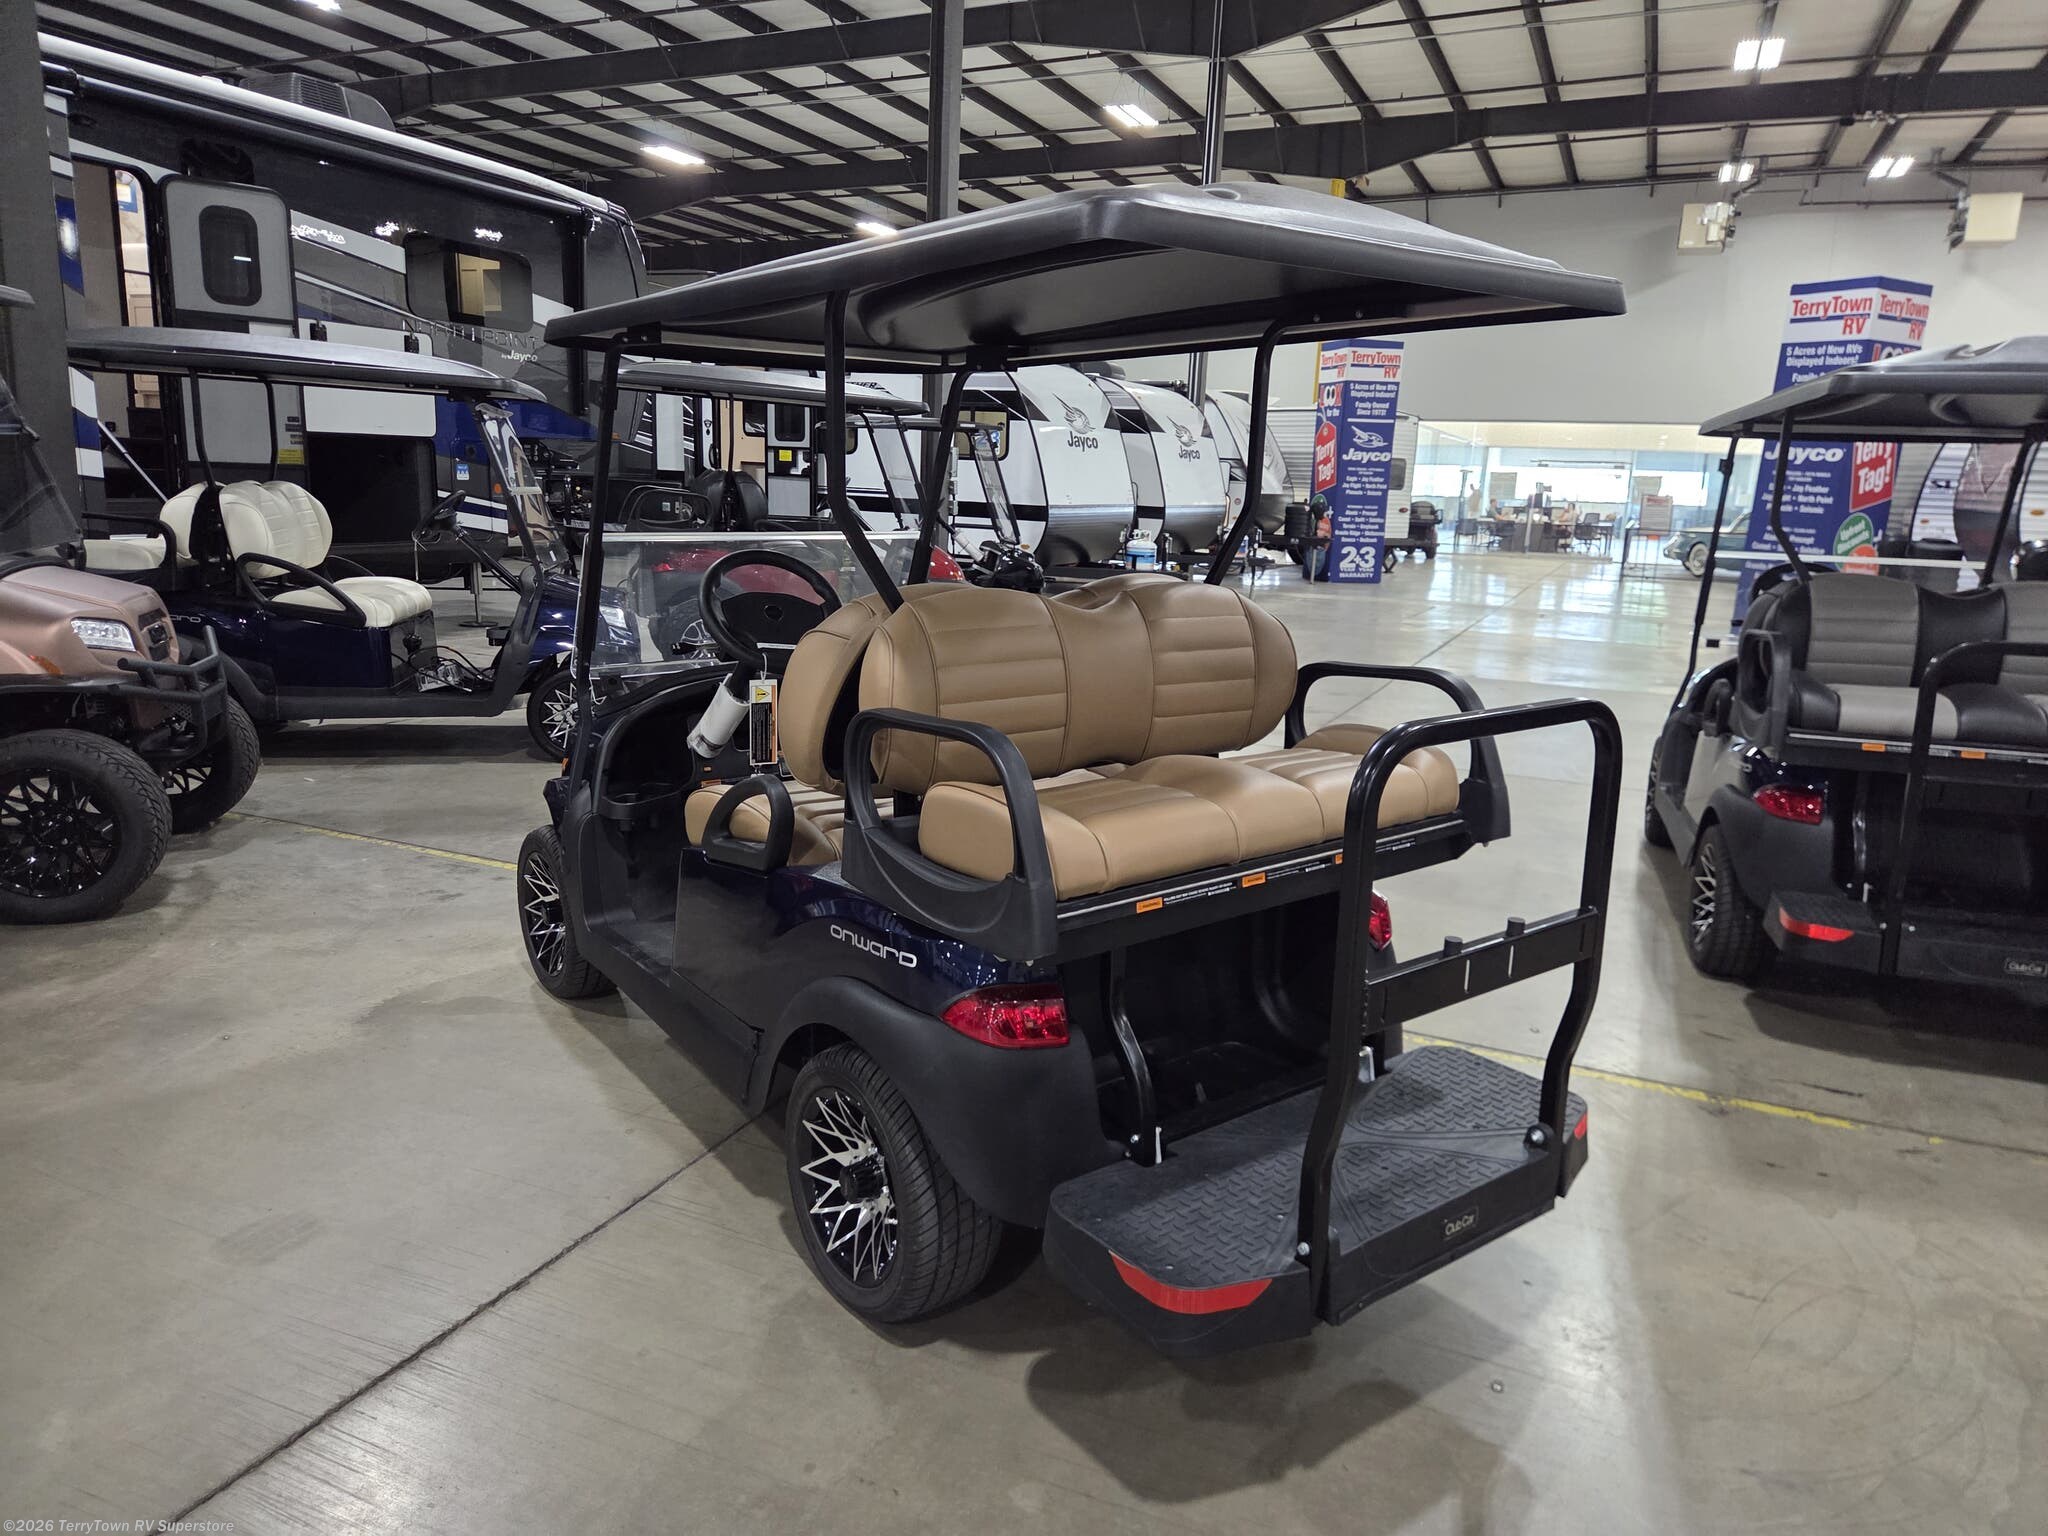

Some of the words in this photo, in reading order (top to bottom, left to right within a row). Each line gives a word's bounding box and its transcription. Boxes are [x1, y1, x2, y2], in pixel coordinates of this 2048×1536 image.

[1793, 296, 1873, 319] TerryTown
[1881, 294, 1929, 318] TerryTown
[1842, 317, 1866, 335] RV
[1909, 321, 1925, 340] RV
[508, 350, 538, 362] Jayco
[1786, 347, 1792, 356] 5
[1793, 346, 1816, 356] Acres
[1818, 345, 1826, 355] of
[1827, 344, 1845, 355] New
[1846, 343, 1863, 354] RVs
[1352, 351, 1401, 367] TerryTown
[1786, 356, 1824, 368] Displayed
[1825, 355, 1859, 365] Indoors!
[1384, 367, 1398, 378] RV
[1068, 431, 1099, 452] Jayco
[1179, 445, 1200, 462] Jayco
[1316, 439, 1335, 462] Terry
[1342, 448, 1392, 464] Jayco
[1858, 458, 1892, 495] Tag!
